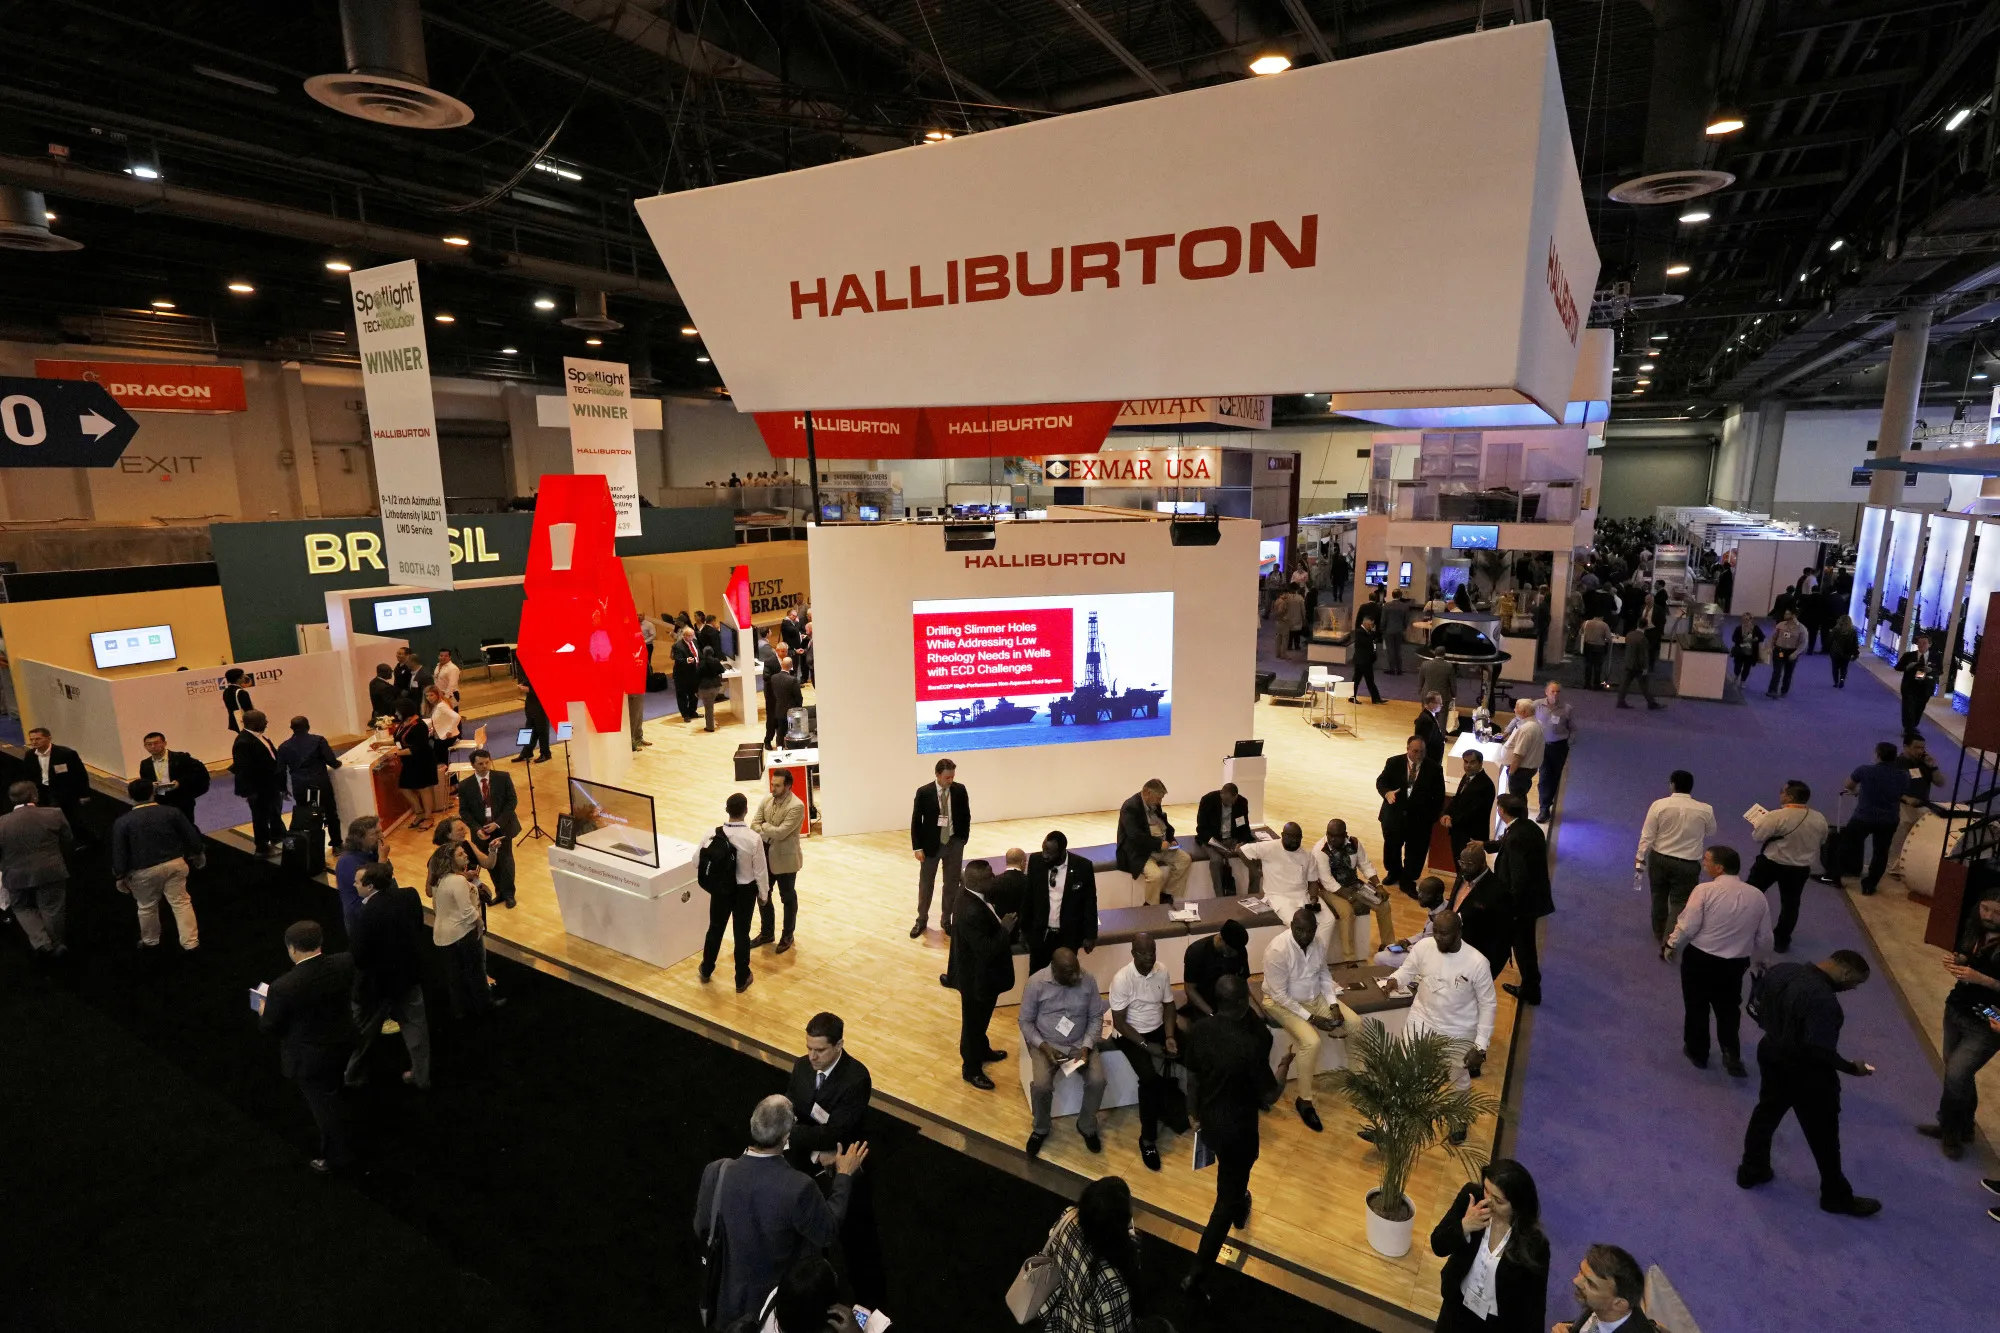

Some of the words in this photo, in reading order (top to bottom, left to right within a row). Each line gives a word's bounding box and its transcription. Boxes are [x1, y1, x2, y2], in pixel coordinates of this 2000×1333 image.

[790, 214, 1318, 319] HALLIBURTON
[363, 314, 415, 333] TECHNOLOGY
[365, 347, 424, 375] WINNER
[110, 383, 211, 398] DRAGON
[573, 386, 624, 397] TECHNOLOGY
[573, 403, 628, 419] WINNER
[1120, 398, 1206, 416] XMAR
[1232, 396, 1265, 422] EXMAR
[374, 428, 431, 438] HALLIBURTON
[794, 416, 900, 435] HALLIBURTON
[949, 415, 1073, 435] HALLIBURTON
[121, 456, 202, 474] EXIT
[1069, 459, 1153, 480] EXMAR
[1166, 458, 1210, 480] USA
[382, 495, 397, 505] 9-1/2
[399, 496, 411, 505] inch
[412, 496, 441, 506] Azimuthal
[385, 510, 420, 523] Lithodensity
[397, 525, 410, 534] LWD
[411, 525, 433, 536] Service
[305, 527, 500, 574] BRSIL
[965, 552, 1126, 569] HALLIBURTON
[399, 561, 425, 576] BOOTH
[426, 563, 441, 577] 439
[749, 579, 783, 597] VEST
[926, 625, 961, 637] Drilling
[964, 624, 1006, 635] Slimmer
[1008, 622, 1037, 633] Holes
[926, 639, 956, 650] While
[957, 637, 1014, 649] Addressing
[1016, 636, 1037, 646] Low
[927, 652, 976, 664] Rheology
[978, 649, 1010, 661] Needs
[1012, 650, 1022, 659] in
[1024, 648, 1051, 659] Wells
[256, 668, 283, 681] anp
[927, 667, 948, 677] with
[951, 665, 975, 676] ECD
[977, 663, 1033, 675] Challenges
[187, 683, 218, 696] Brazil
[954, 681, 997, 689] High-Performance
[624, 878, 640, 887] Service
